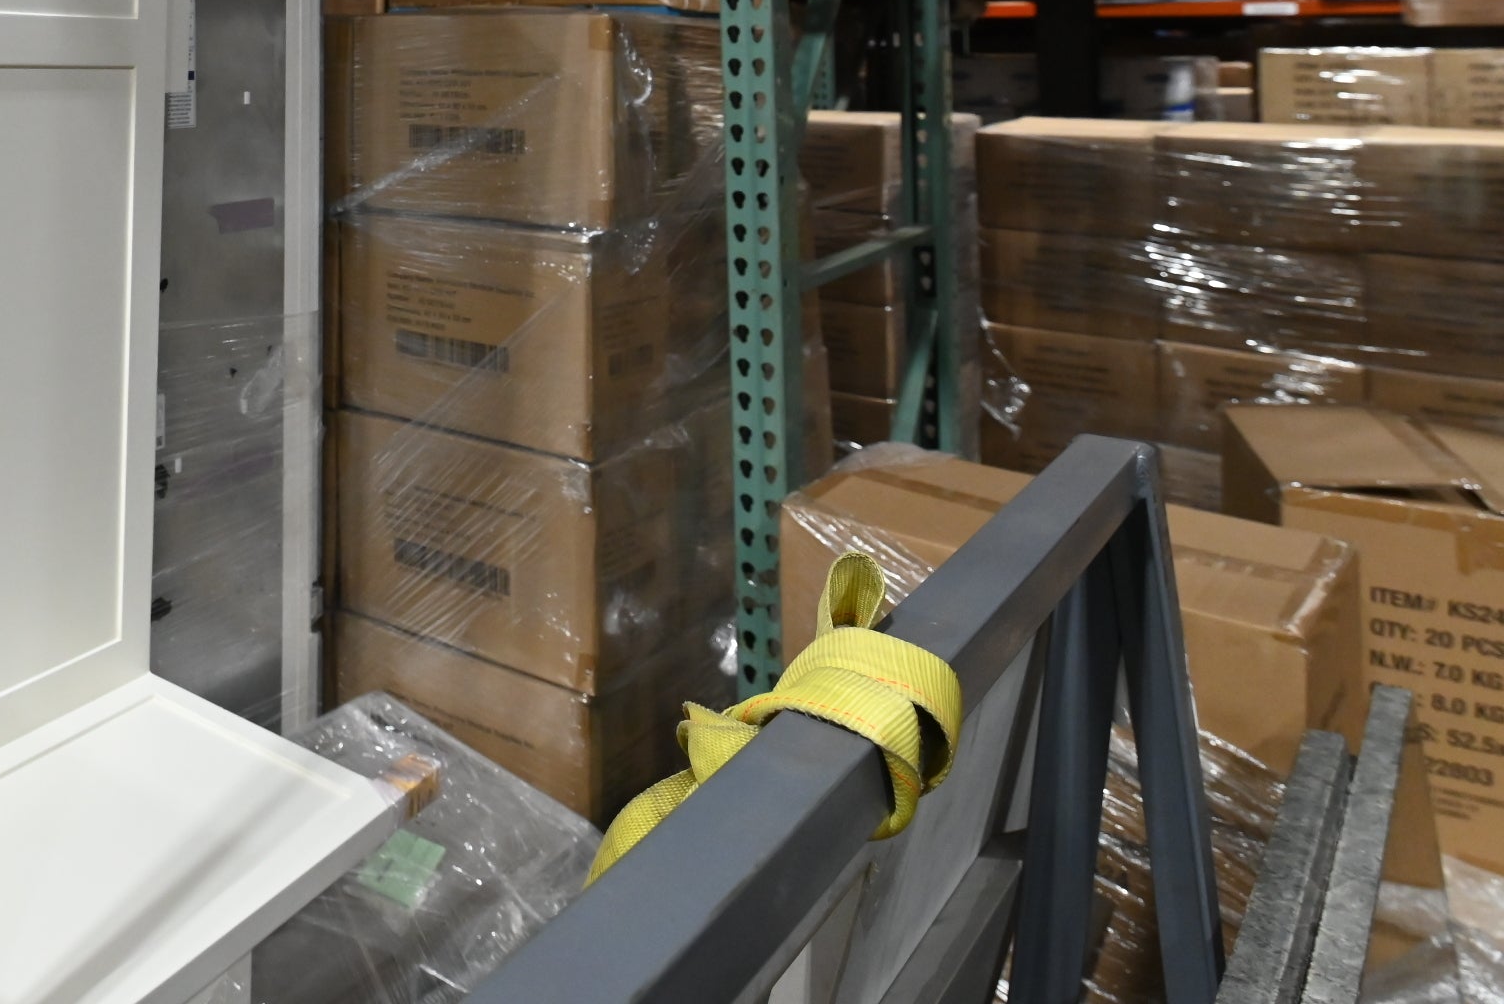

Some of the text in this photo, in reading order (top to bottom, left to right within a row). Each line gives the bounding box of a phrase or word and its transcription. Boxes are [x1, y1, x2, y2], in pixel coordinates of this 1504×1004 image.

[1369, 617, 1504, 660] QTY: 20 PCS
[1431, 693, 1467, 715] 8.0
